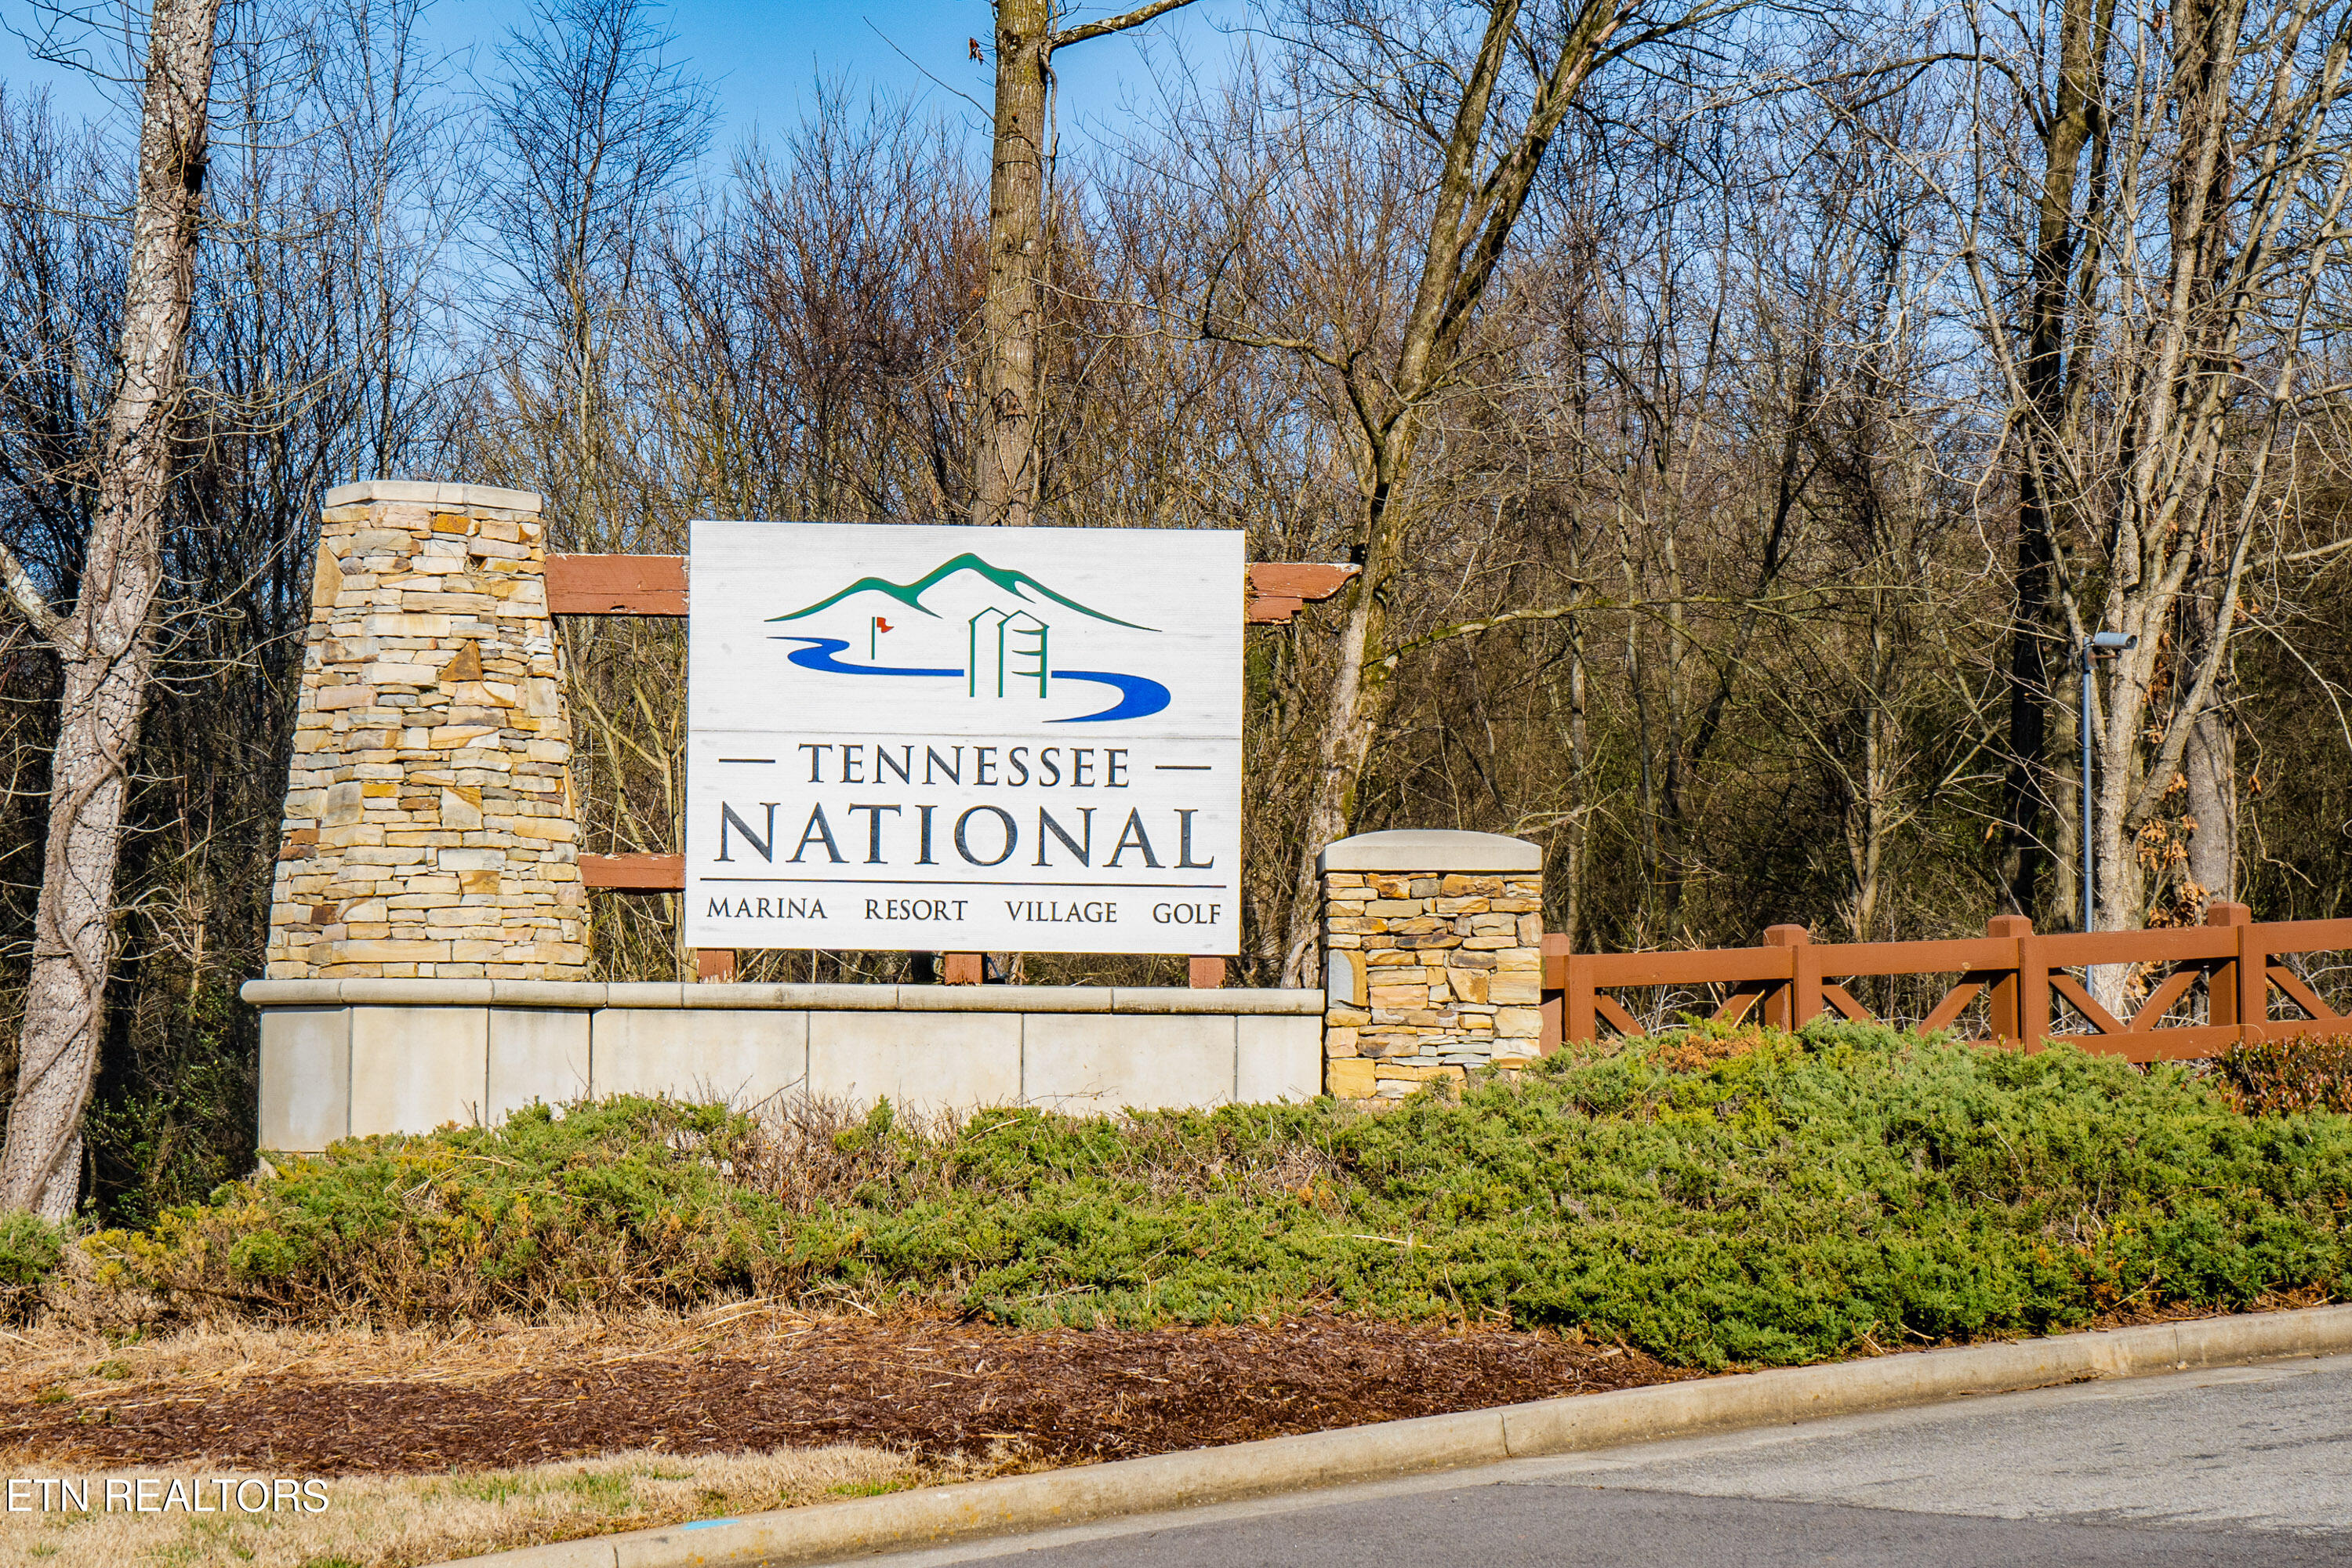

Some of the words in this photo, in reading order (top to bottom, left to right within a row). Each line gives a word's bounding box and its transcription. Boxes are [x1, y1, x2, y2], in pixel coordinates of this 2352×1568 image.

[798, 742, 1130, 788] TENNESSEE
[713, 800, 1215, 870] NATIONAL
[706, 897, 829, 920] MARINA
[864, 898, 969, 922] RESORT
[1004, 900, 1118, 924] VILLAGE
[1152, 902, 1221, 925] GOLF
